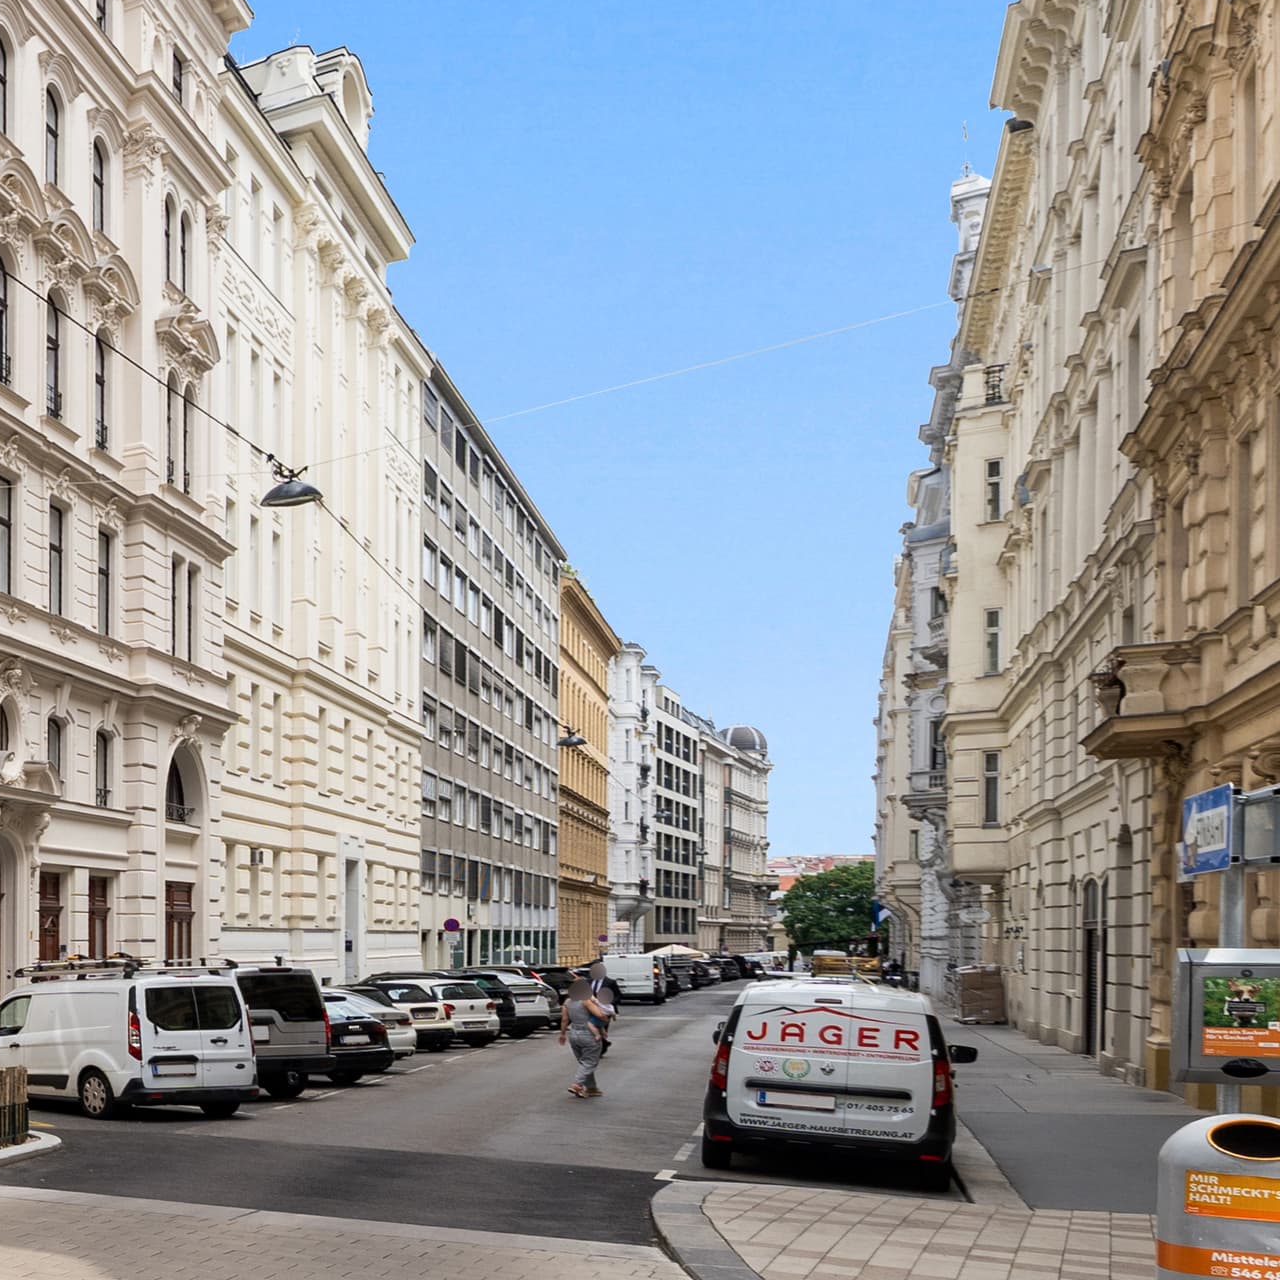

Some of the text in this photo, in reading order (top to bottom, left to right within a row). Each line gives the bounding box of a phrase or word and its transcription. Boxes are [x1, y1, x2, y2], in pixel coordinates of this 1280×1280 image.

[746, 1021, 921, 1051] JÄGER
[865, 1104, 884, 1112] 405
[887, 1105, 899, 1113] 75
[740, 1117, 917, 1140] WWW.JAEGER-HAUSBETREUUNG.AT
[1189, 1174, 1219, 1185] MIR
[1188, 1193, 1232, 1205] HALT!
[1211, 1252, 1280, 1268] Misttele
[1231, 1267, 1262, 1280] 546
